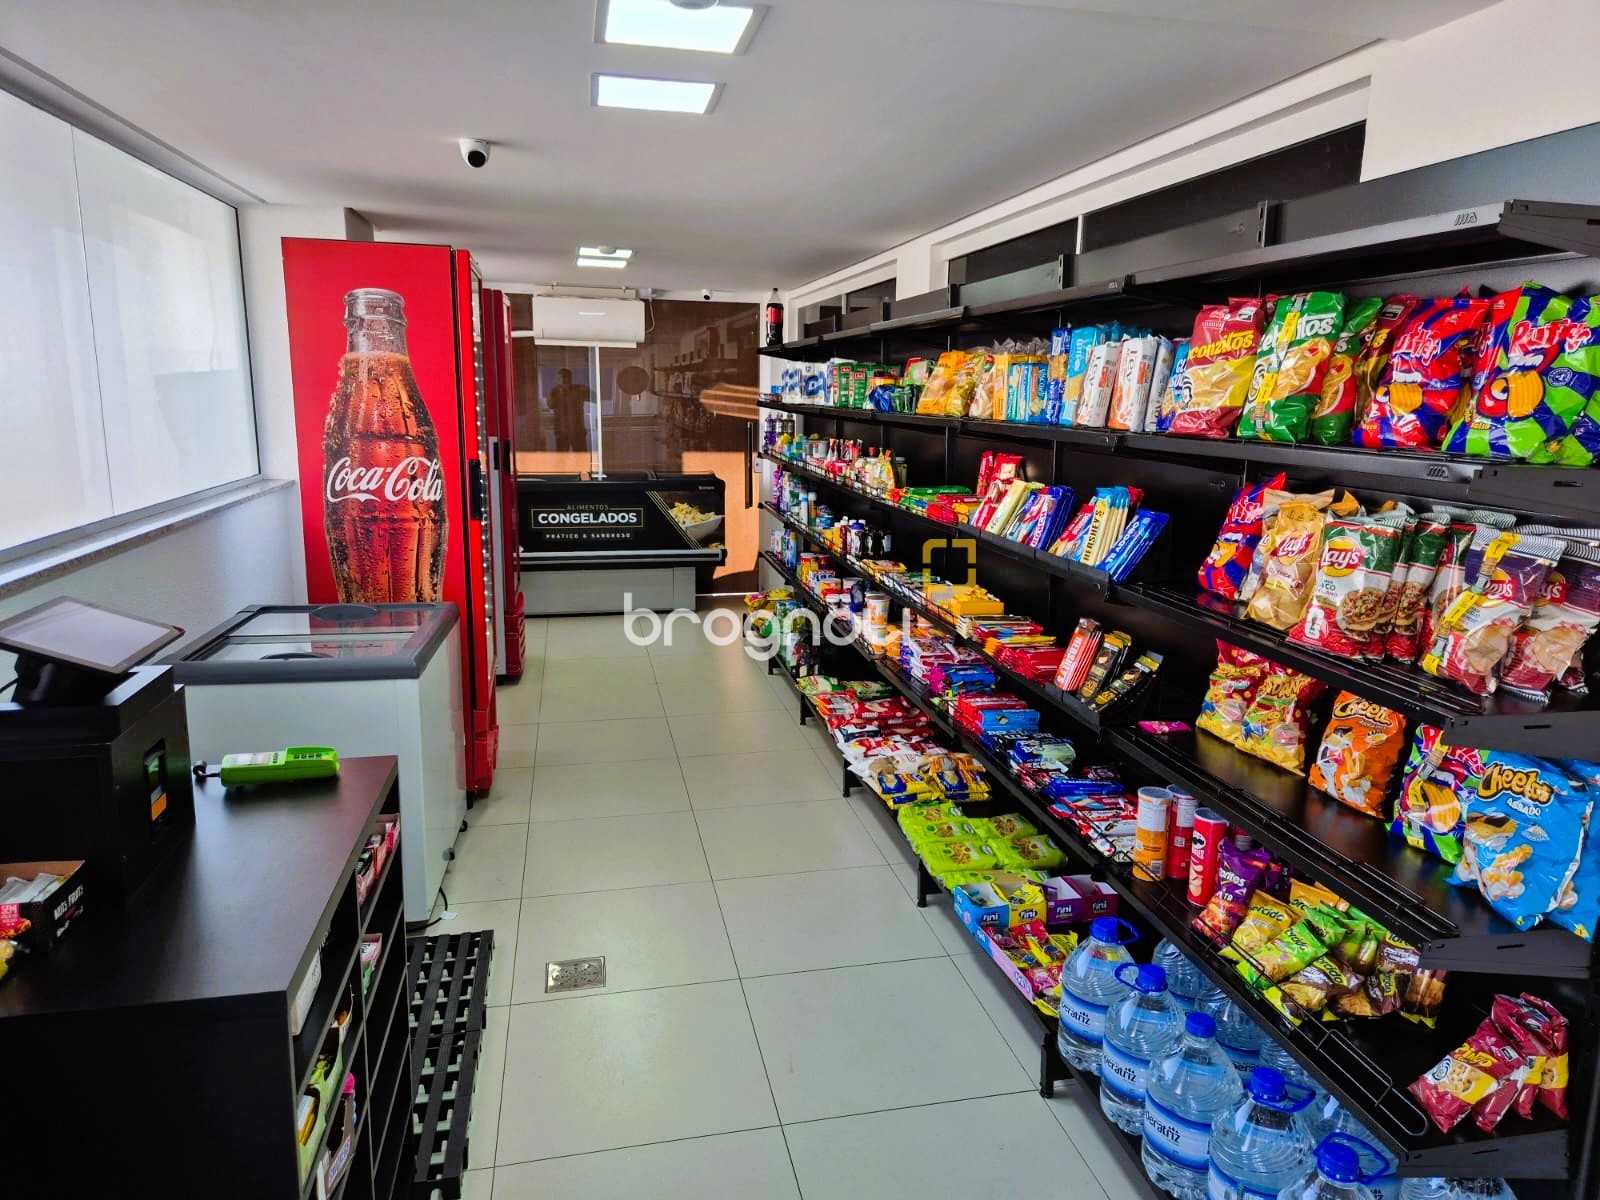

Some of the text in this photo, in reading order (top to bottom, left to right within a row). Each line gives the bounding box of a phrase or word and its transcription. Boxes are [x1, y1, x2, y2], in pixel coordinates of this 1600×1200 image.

[1189, 330, 1255, 360] conzitos
[1508, 317, 1592, 354] Ruffles
[327, 455, 443, 502] Coca-Cola
[538, 512, 638, 525] CONGELADOS
[1475, 761, 1554, 807] Cheetos
[1219, 867, 1247, 888] oritos
[1145, 1111, 1181, 1144] peratriz
